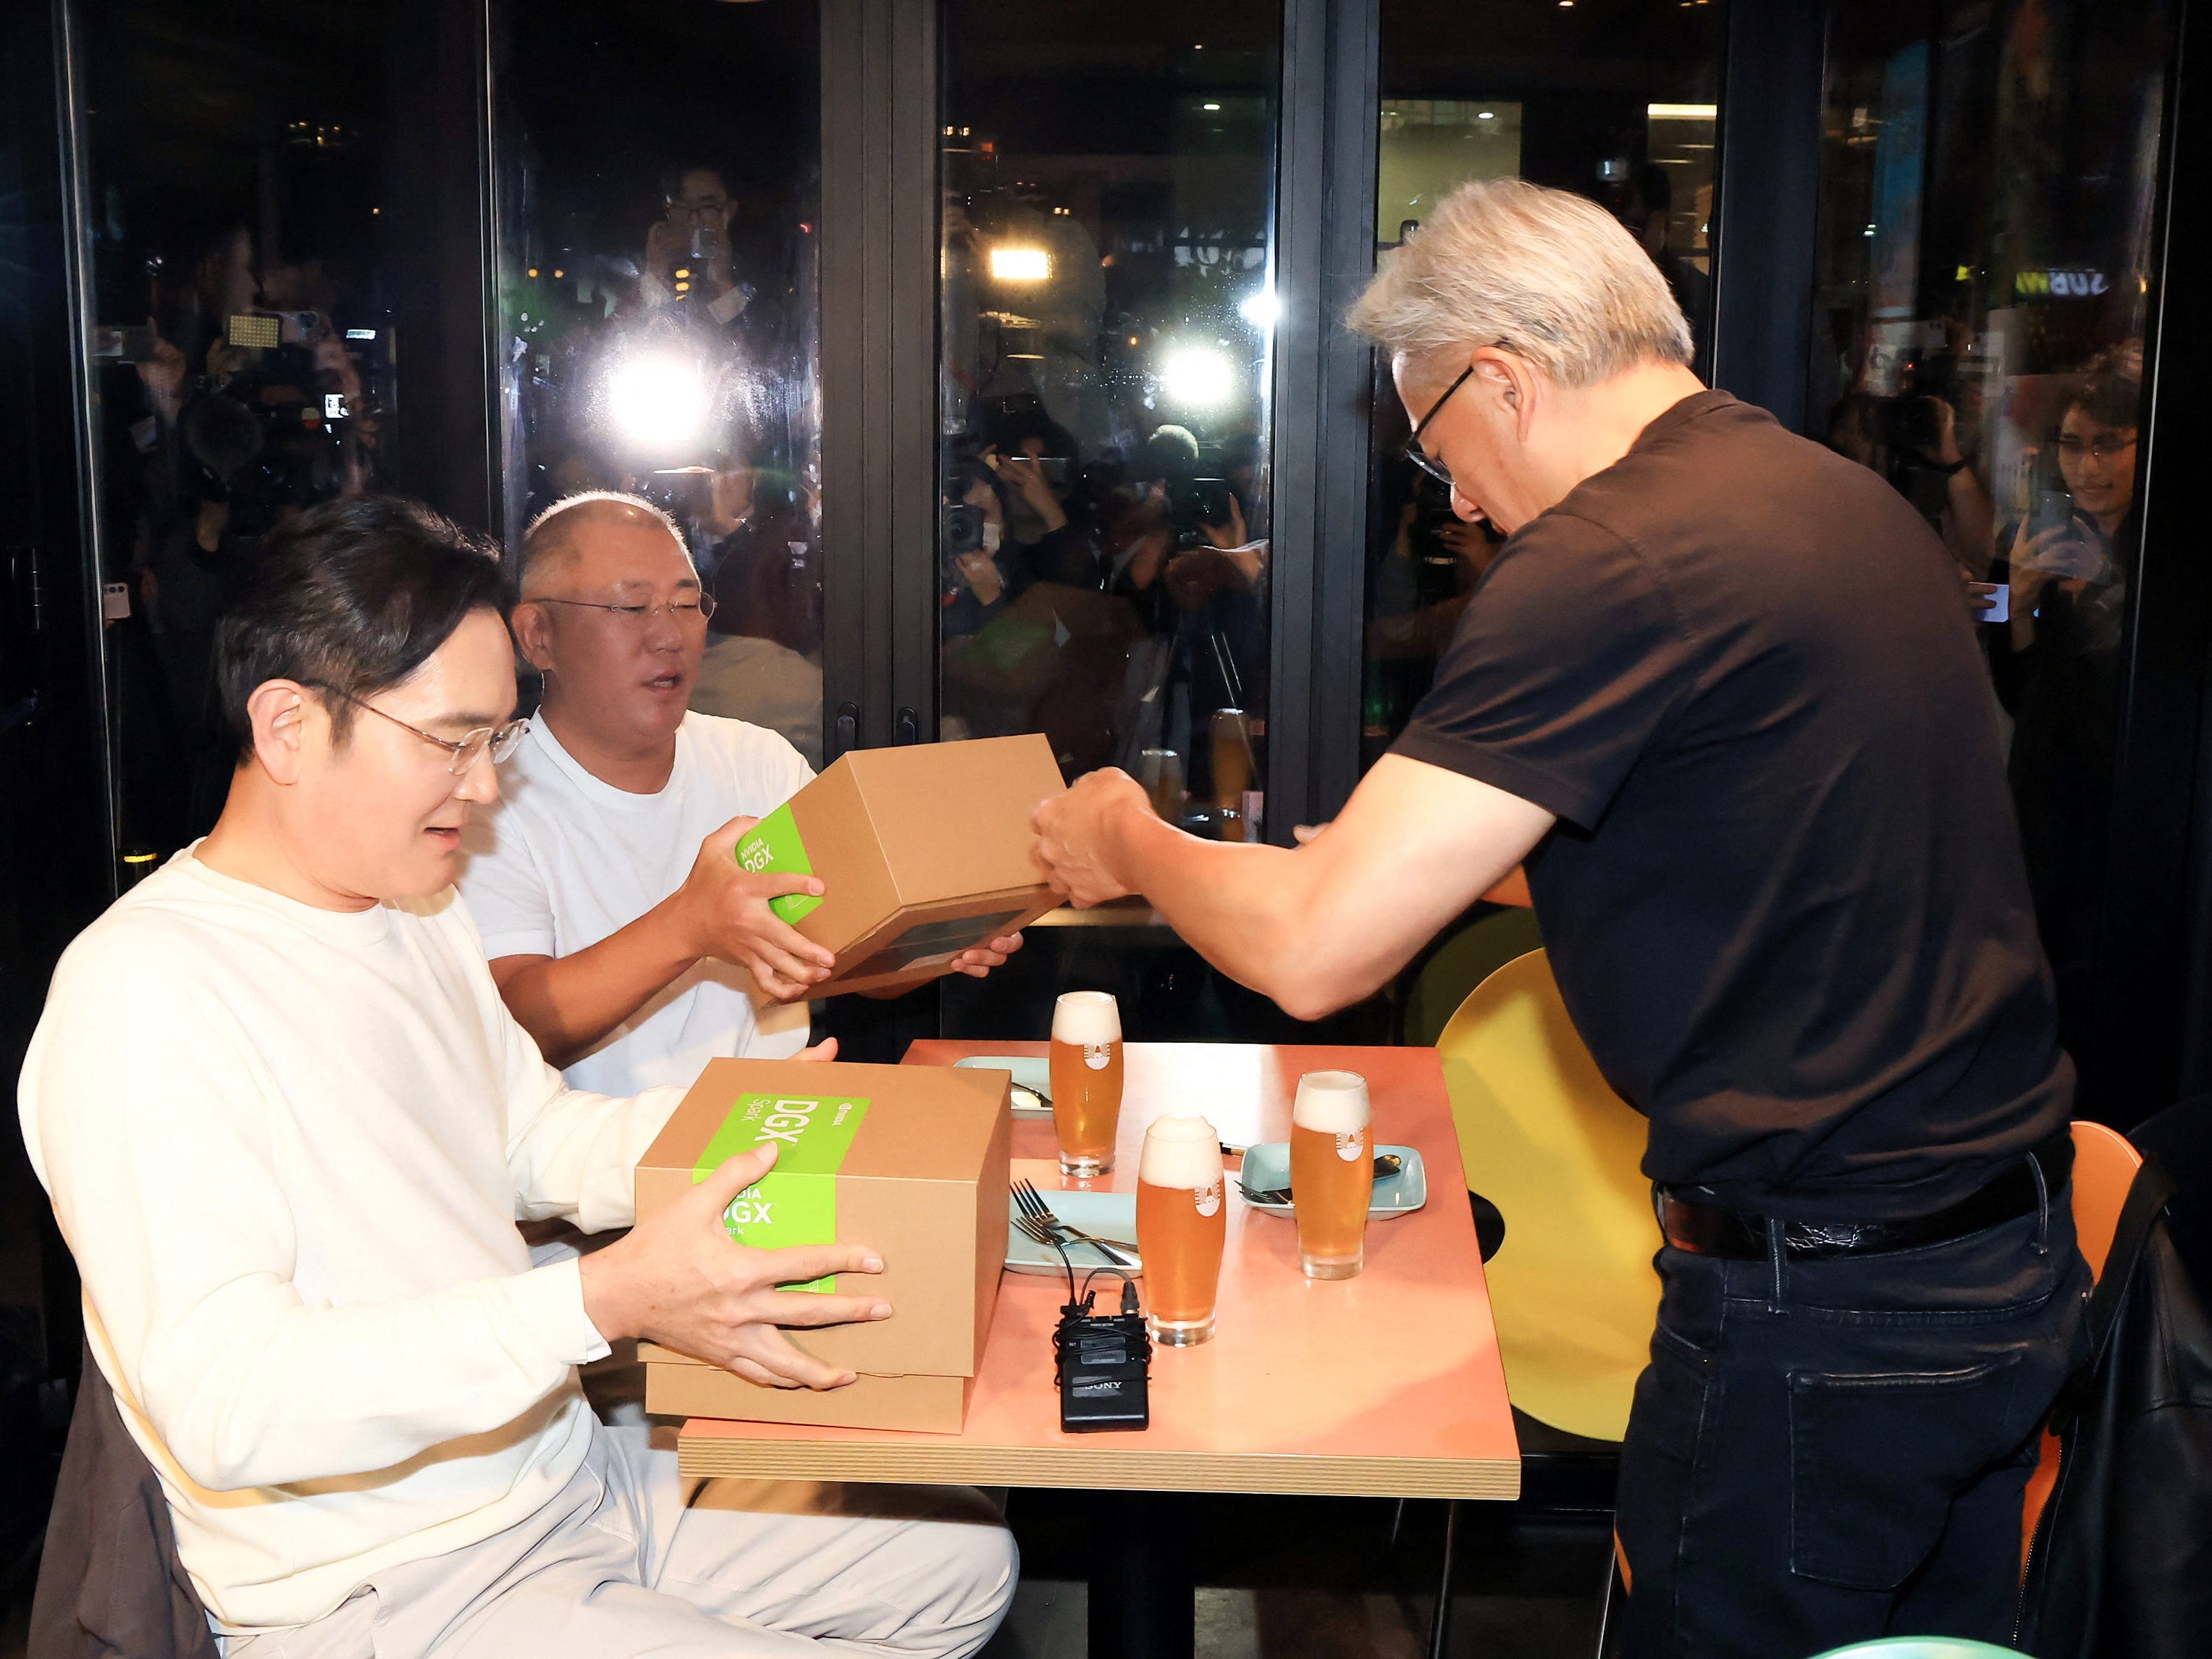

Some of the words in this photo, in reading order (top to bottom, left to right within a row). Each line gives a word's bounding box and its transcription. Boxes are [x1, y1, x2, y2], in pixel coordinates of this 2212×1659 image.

[741, 837, 764, 860] NVIDIA
[744, 844, 774, 873] DGX
[741, 1099, 771, 1122] Spark
[754, 1100, 819, 1143] DGX
[736, 1188, 762, 1199] DIA
[726, 1225, 744, 1235] ark
